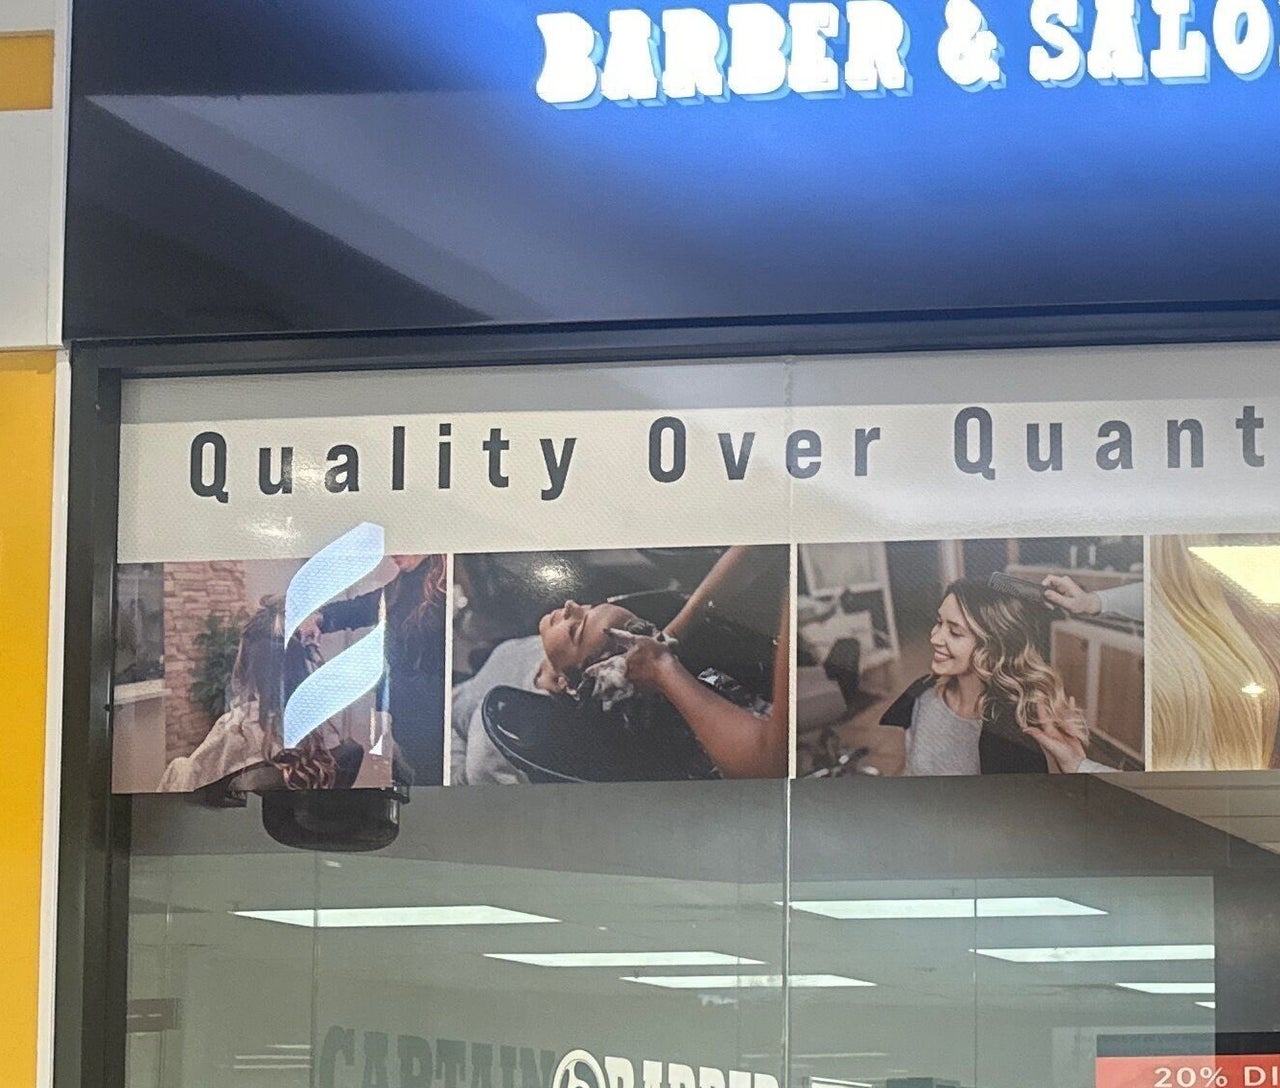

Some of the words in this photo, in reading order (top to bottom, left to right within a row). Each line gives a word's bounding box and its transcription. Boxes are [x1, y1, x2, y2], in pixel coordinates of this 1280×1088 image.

[536, 2, 913, 109] BARBER
[938, 0, 1005, 88] &
[188, 424, 579, 501] Quality
[647, 416, 883, 484] Over
[1153, 1065, 1229, 1088] 20%
